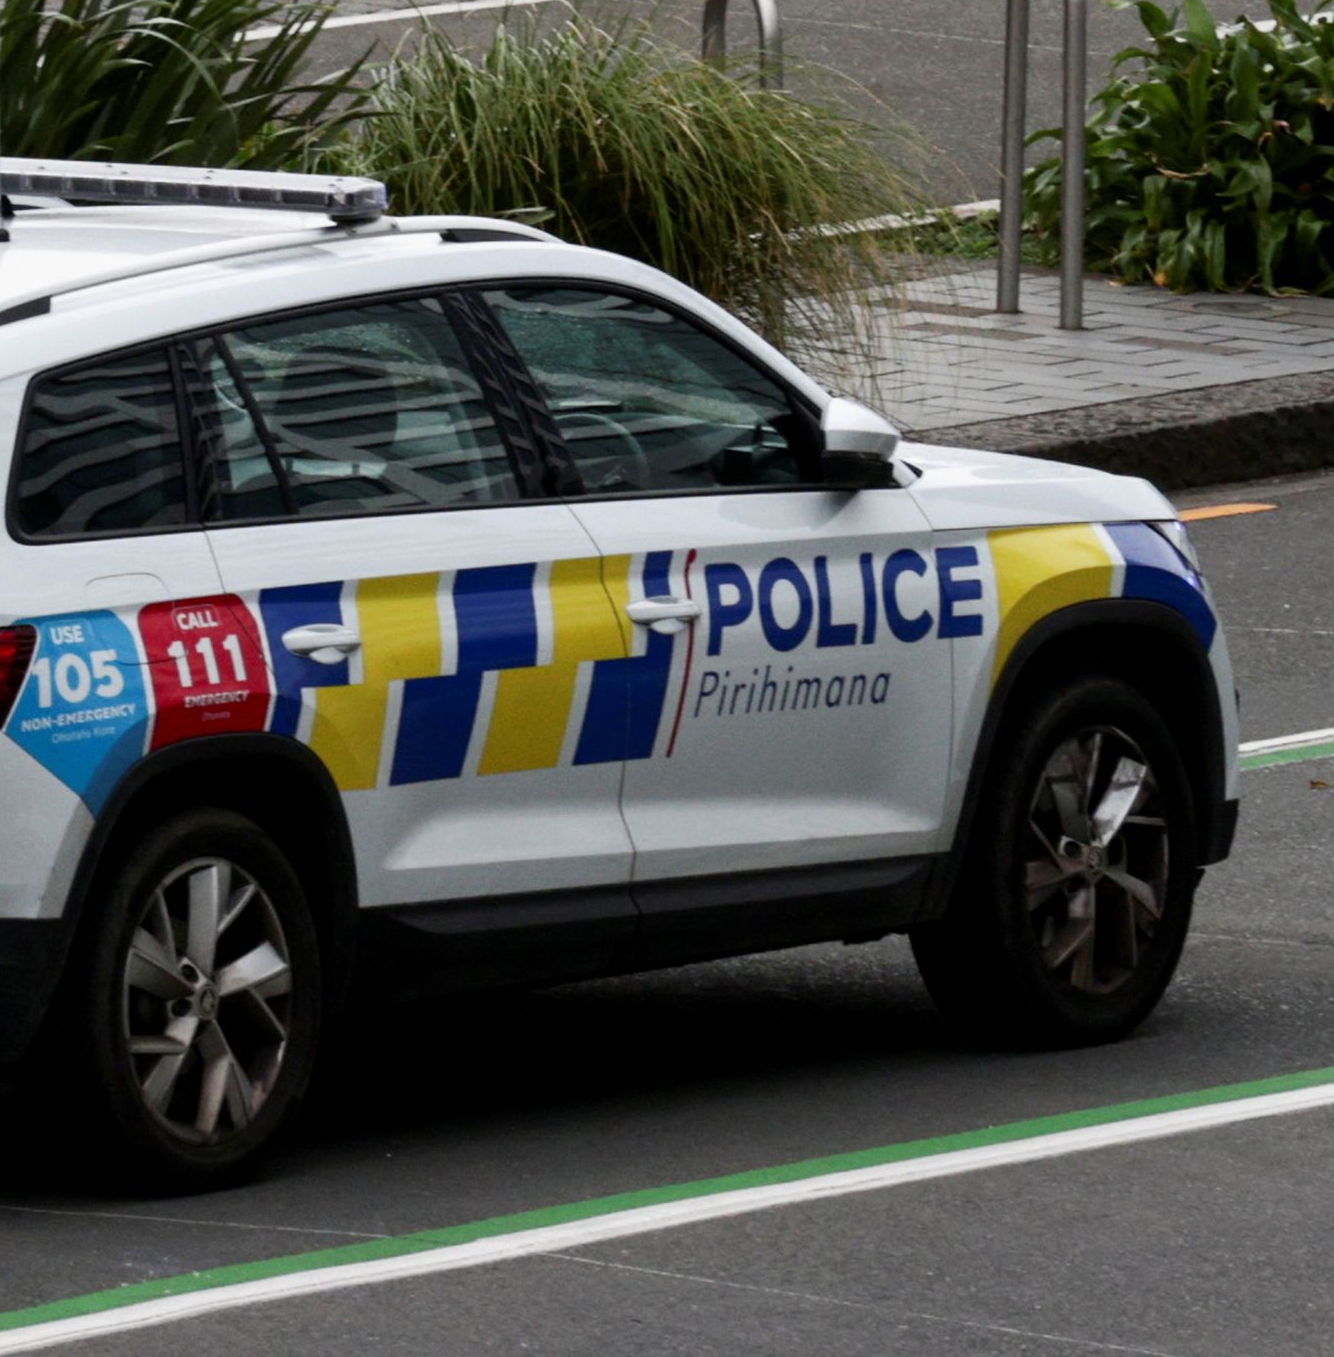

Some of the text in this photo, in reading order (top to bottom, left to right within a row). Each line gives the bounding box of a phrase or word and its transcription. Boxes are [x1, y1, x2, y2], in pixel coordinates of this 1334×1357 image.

[177, 610, 219, 631] CALL
[704, 545, 983, 657] POLICE
[50, 624, 84, 645] USE
[31, 648, 125, 709] 105
[167, 634, 248, 688] 111
[184, 689, 250, 709] EMERGENCY
[693, 664, 892, 719] Pirihimana
[21, 703, 136, 733] NON-EMERGENCY
